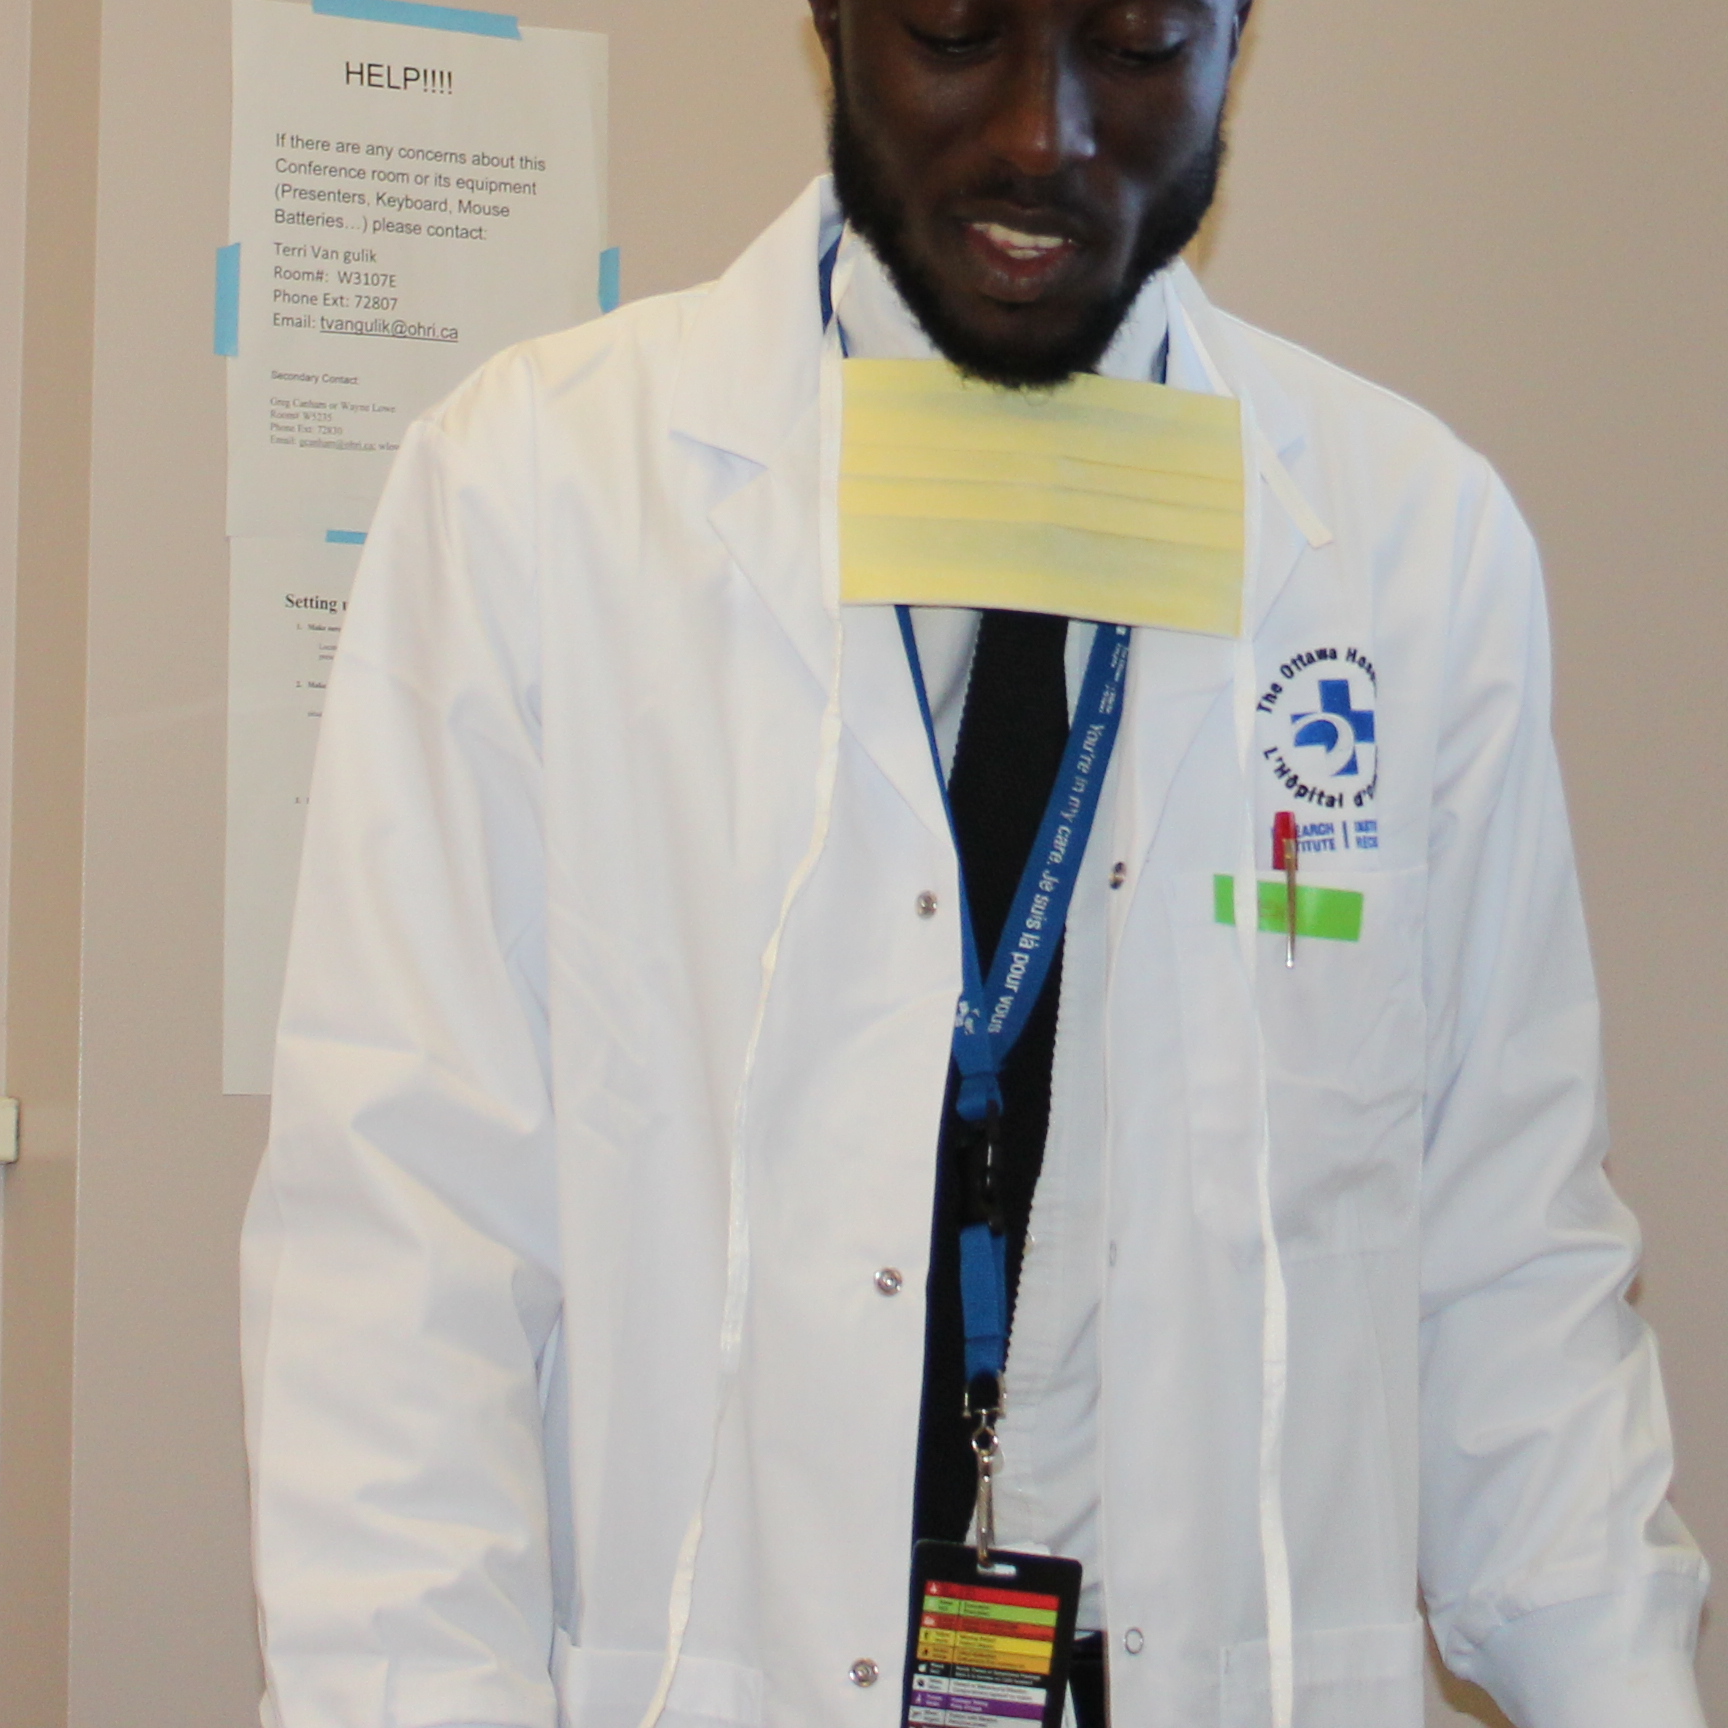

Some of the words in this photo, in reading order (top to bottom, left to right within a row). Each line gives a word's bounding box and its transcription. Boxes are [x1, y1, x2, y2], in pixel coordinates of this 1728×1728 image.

[345, 60, 454, 96] HELP!!!!
[276, 133, 287, 148] If
[290, 134, 331, 152] there
[335, 141, 361, 155] are
[365, 143, 394, 161] any
[397, 146, 468, 165] concerns
[471, 151, 515, 169] about
[519, 155, 546, 172] this
[275, 157, 367, 180] Conference
[371, 169, 410, 184] room
[414, 173, 430, 186] or
[434, 172, 451, 188] its
[456, 176, 537, 196] equipment
[274, 183, 370, 207] (Presenters,
[375, 191, 452, 215] Keyboard,
[458, 199, 510, 218] Mouse
[372, 217, 422, 236] please
[426, 224, 488, 241] contact:
[273, 242, 307, 258] Terri
[311, 245, 339, 261] Van
[343, 248, 377, 265] gulik
[273, 265, 329, 283] Room#:
[337, 269, 397, 288] W3107E
[273, 288, 319, 306] Phone
[323, 292, 350, 308] Ext:
[354, 294, 399, 311] 72807
[272, 312, 316, 330] Email:
[320, 315, 459, 342] tvangulik@ohri.ca
[284, 592, 339, 614] Setting
[1256, 681, 1283, 714] The
[1280, 647, 1338, 680] Ottawa
[1076, 723, 1105, 774] You're
[1072, 775, 1088, 794] in
[1060, 795, 1081, 823] my
[1046, 825, 1071, 865] care.
[1039, 869, 1060, 893] Je
[1025, 893, 1050, 931] suis
[1003, 951, 1030, 994] pour
[987, 994, 1015, 1034] vous
